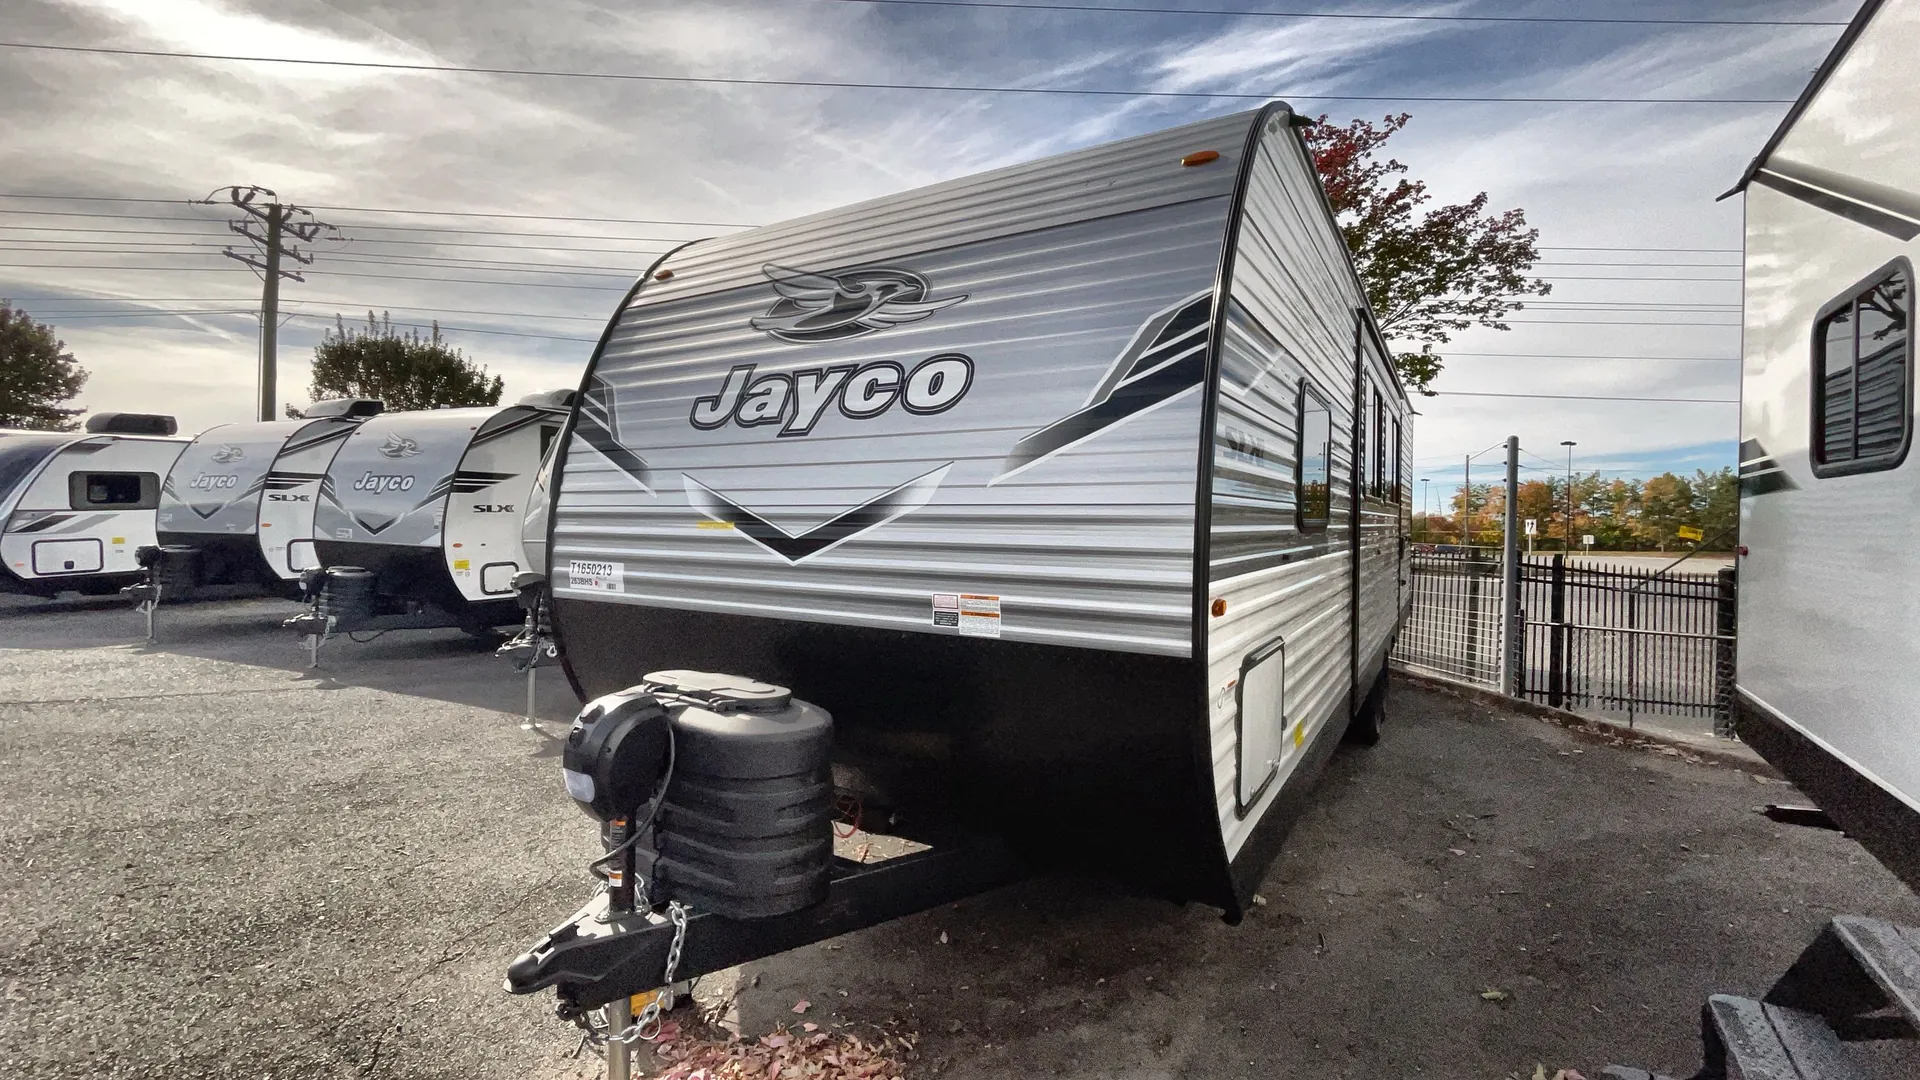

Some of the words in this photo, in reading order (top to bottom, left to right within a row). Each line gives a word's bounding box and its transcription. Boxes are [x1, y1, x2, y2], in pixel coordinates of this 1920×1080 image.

[689, 352, 975, 438] Jayco
[190, 472, 239, 492] Jayco
[353, 471, 416, 495] Jayco
[472, 504, 515, 514] SLX
[571, 562, 613, 576] T1650213
